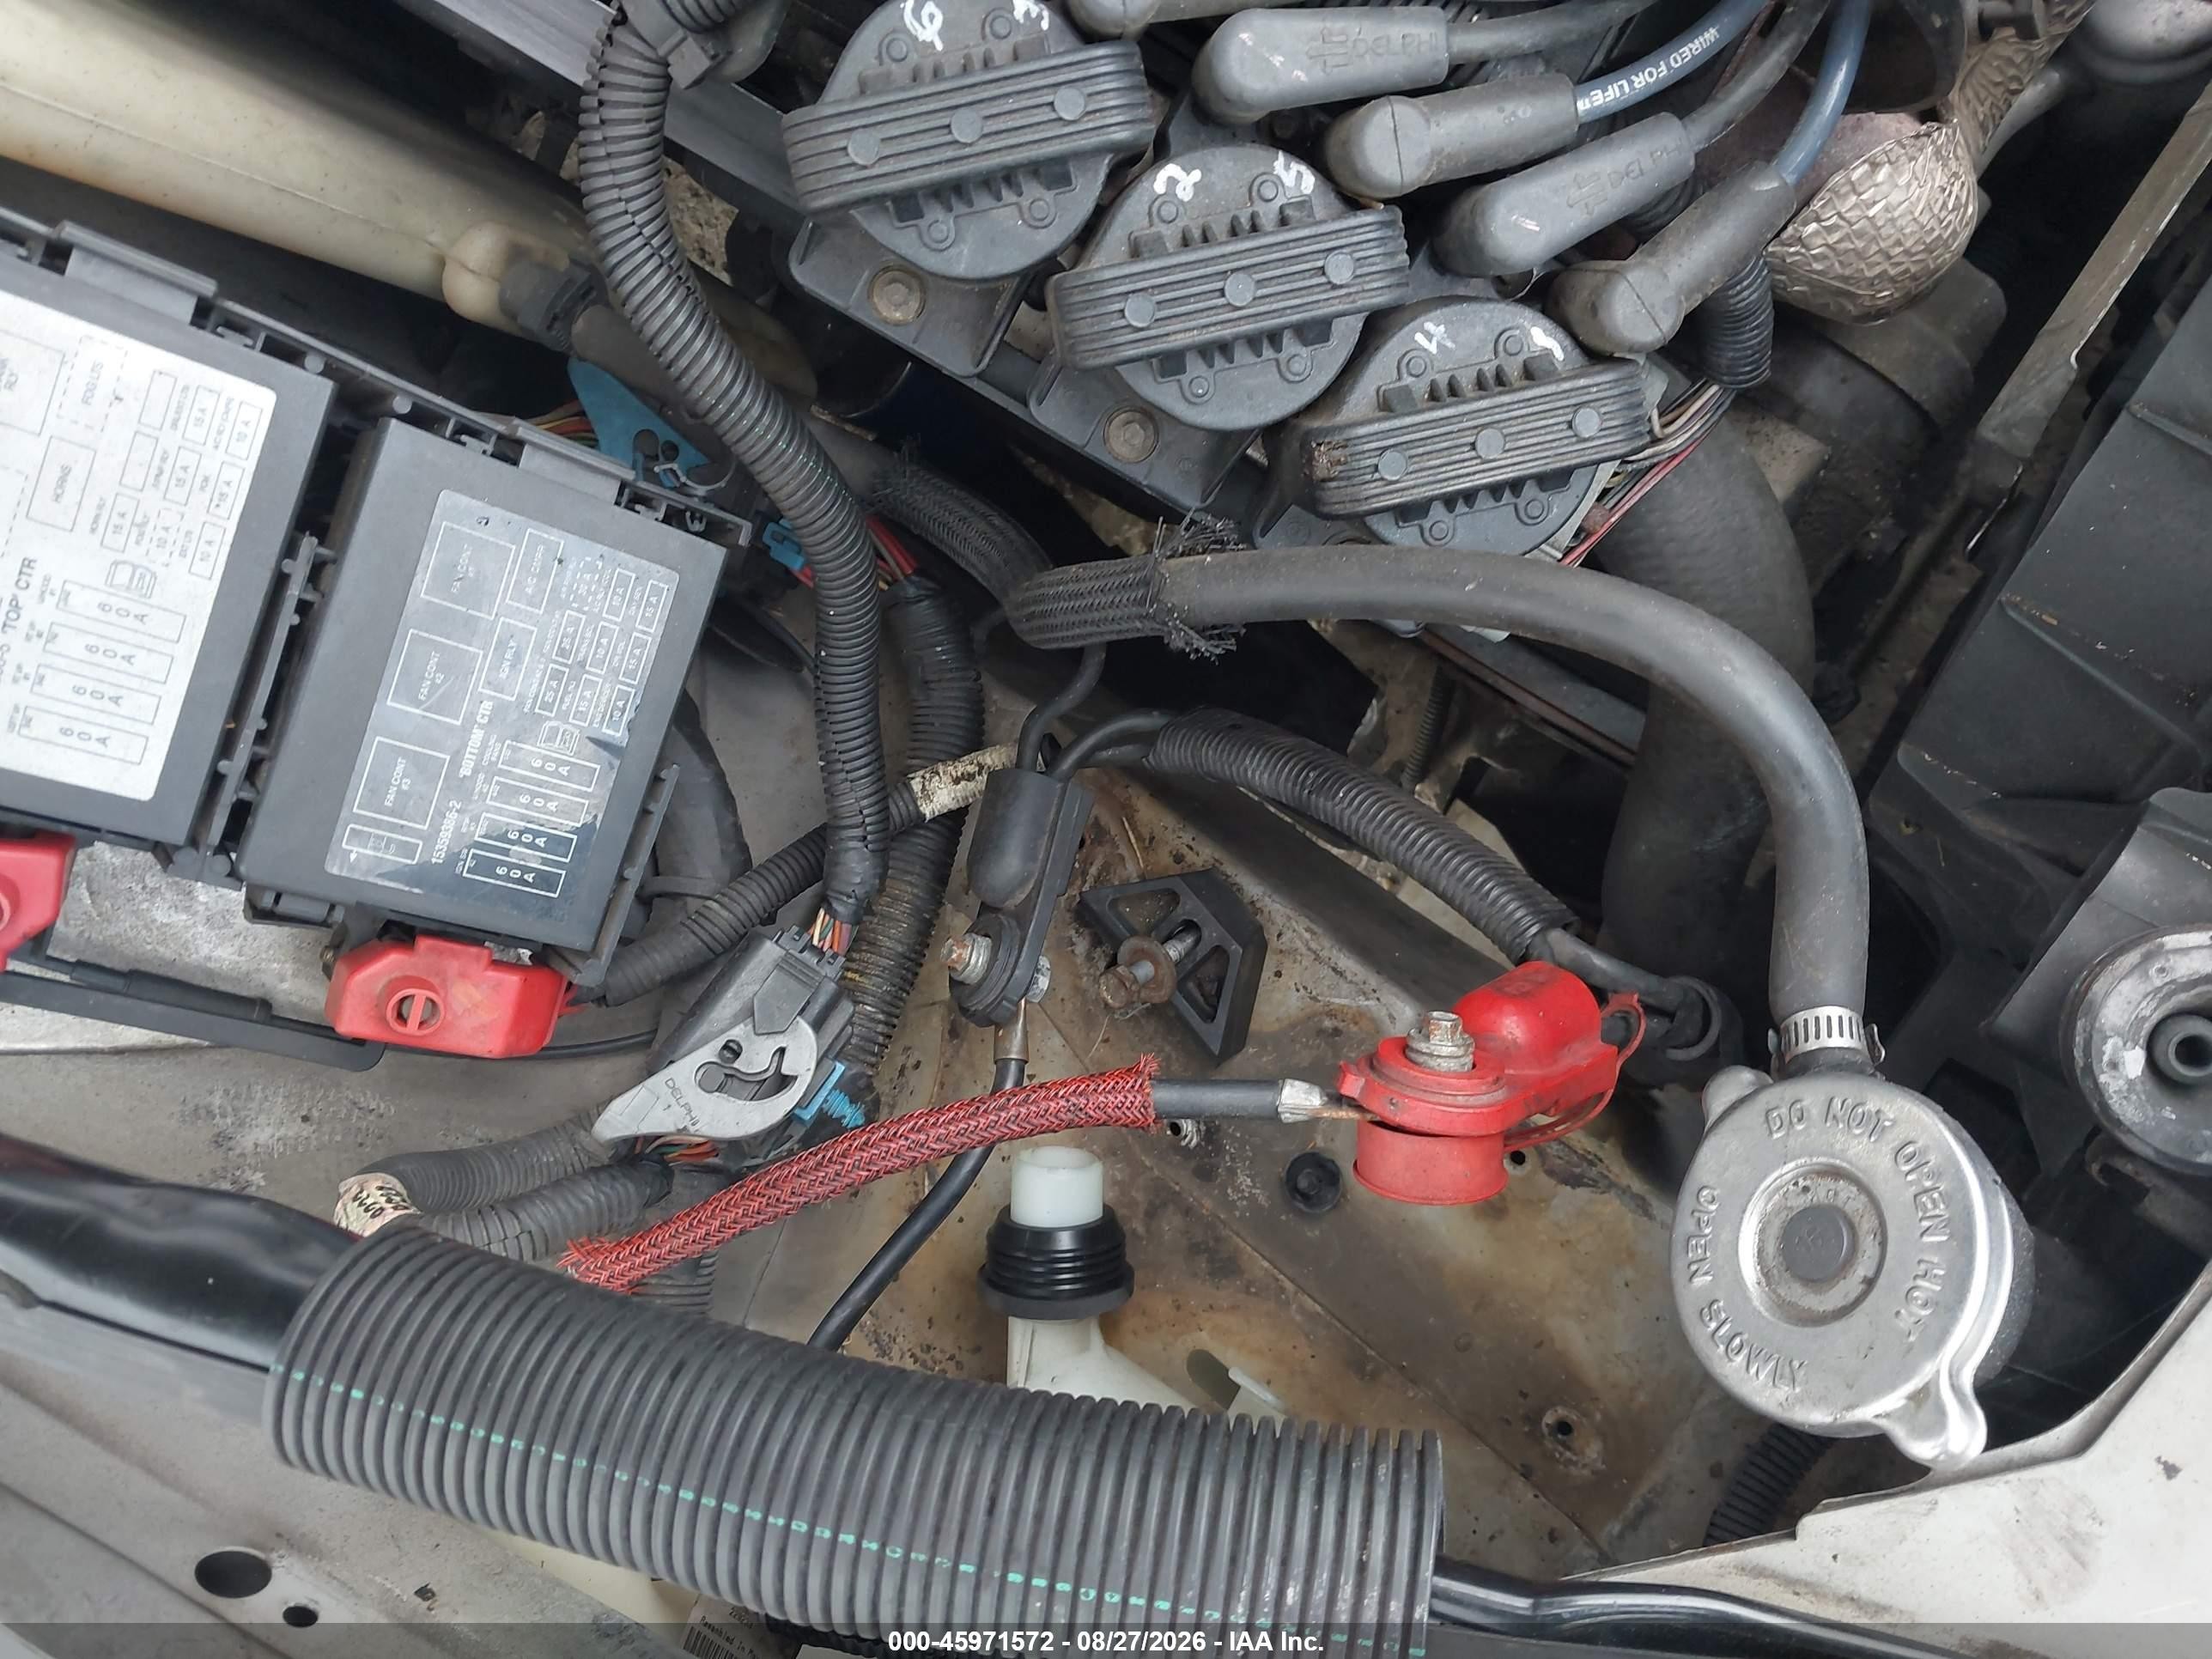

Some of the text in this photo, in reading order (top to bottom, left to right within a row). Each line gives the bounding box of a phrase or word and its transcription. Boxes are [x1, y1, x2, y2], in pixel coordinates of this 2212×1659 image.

[1670, 27, 1720, 69] WIRED
[1631, 61, 1668, 88] FOR
[15, 557, 37, 590] CTR
[615, 586, 624, 595] A
[649, 595, 658, 604] A
[565, 625, 575, 635] A
[595, 636, 609, 659] 10 A
[633, 647, 641, 656] A
[416, 650, 441, 701] FAN CONT
[549, 678, 558, 688] A
[582, 688, 592, 697] A
[475, 698, 495, 725] CTR
[611, 699, 624, 721] 10 A
[383, 756, 407, 806] FAN CONT
[665, 1078, 700, 1126] DELPHI
[1764, 1098, 1805, 1139] DO
[1825, 1095, 1893, 1141] NOT
[1895, 1141, 1952, 1244] OPEN
[1686, 1186, 1807, 1393] OPEN SLOWLY
[1895, 1258, 1948, 1341] HOT
